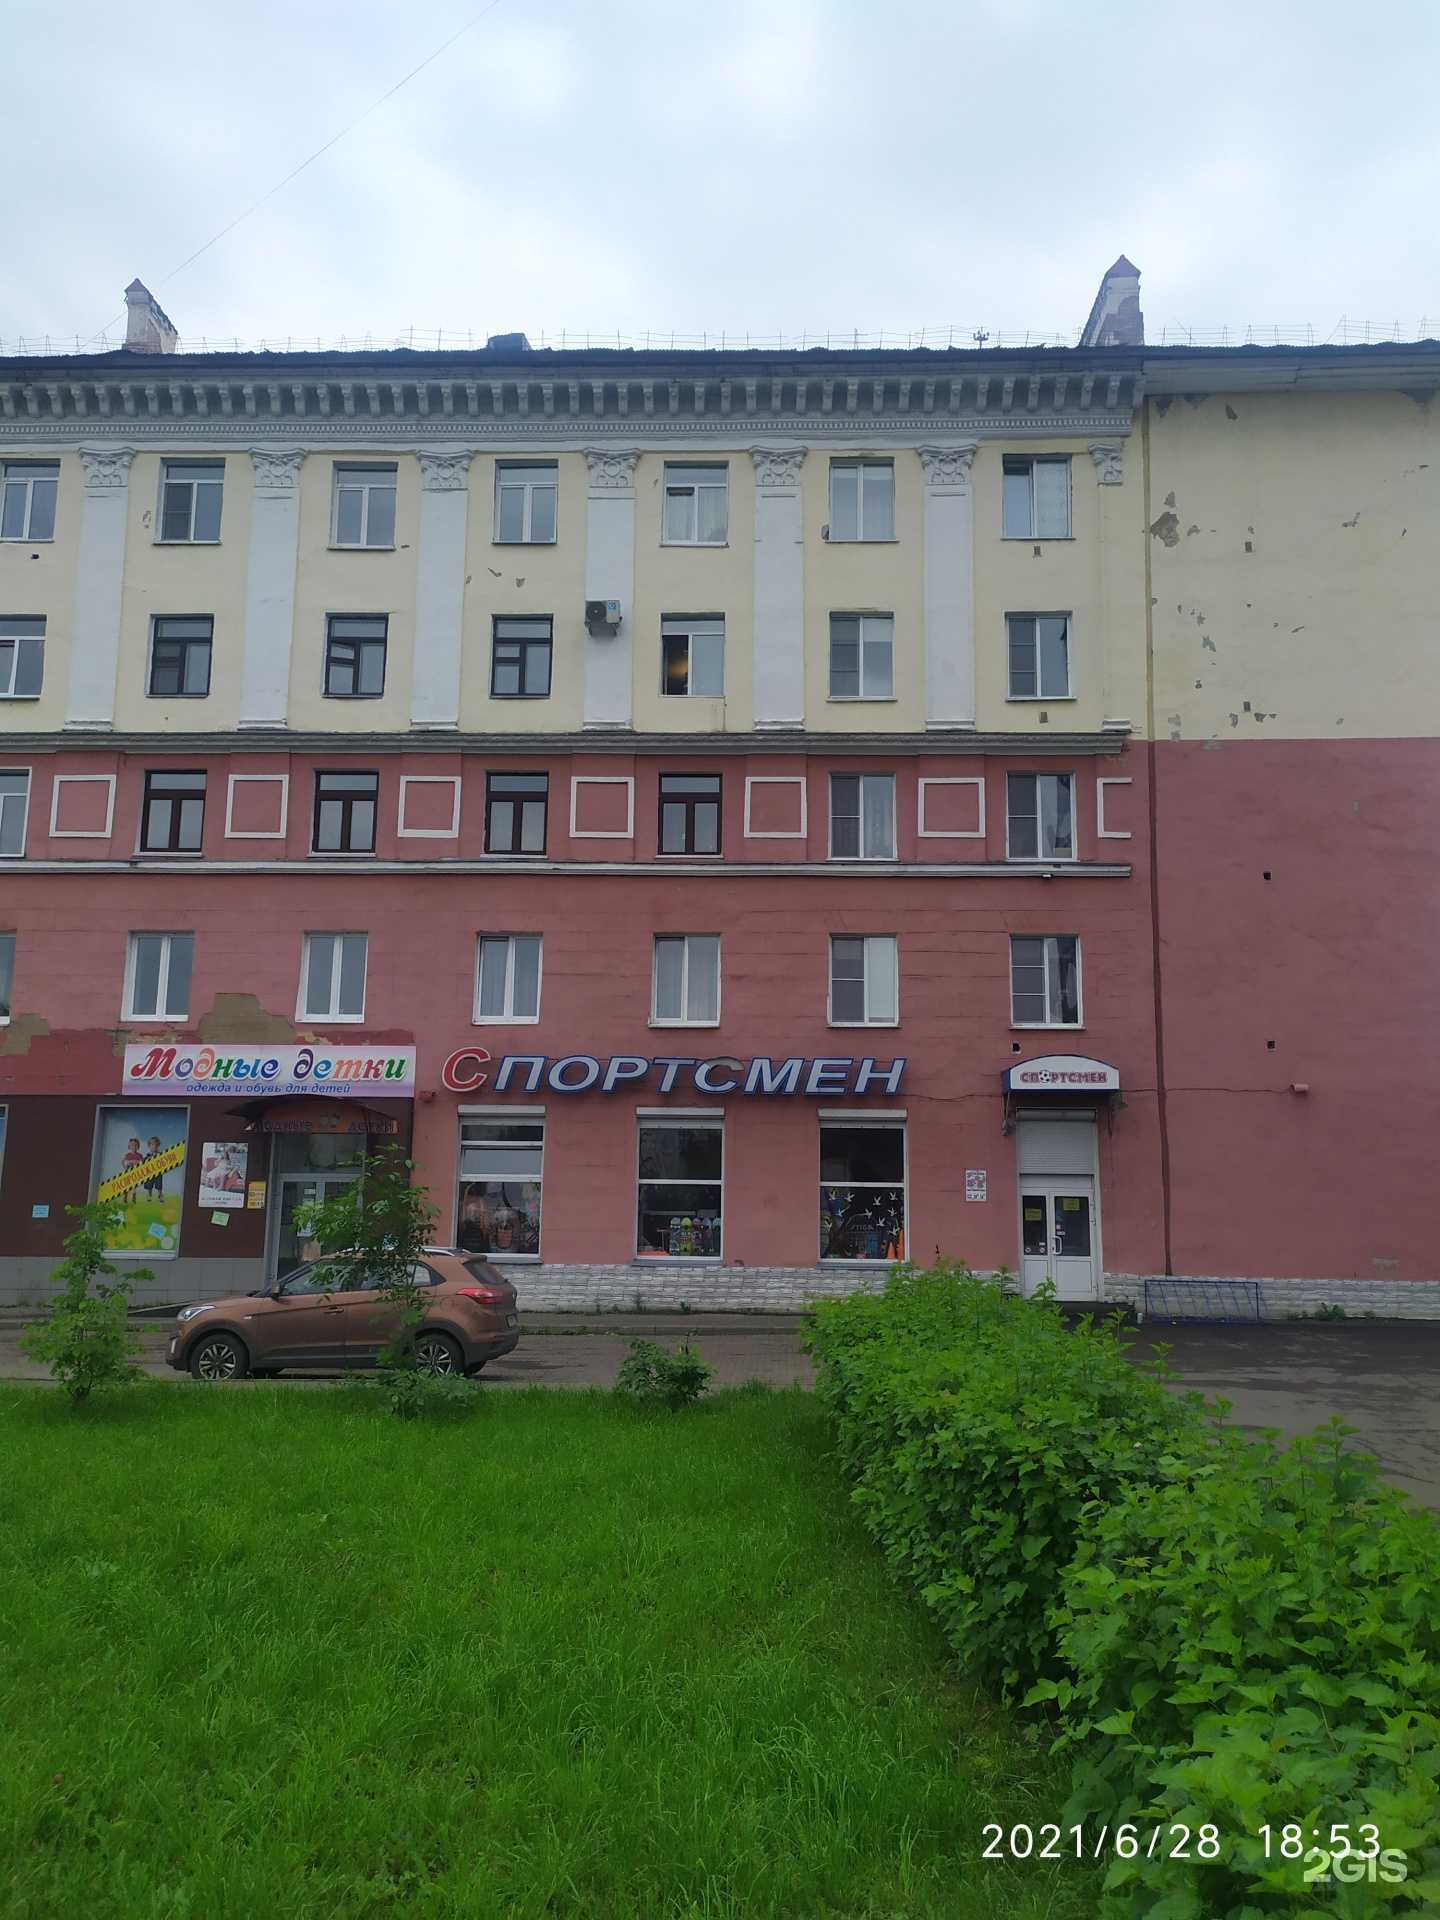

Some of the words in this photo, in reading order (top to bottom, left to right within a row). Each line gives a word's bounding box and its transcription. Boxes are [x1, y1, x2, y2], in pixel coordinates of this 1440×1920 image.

[130, 1047, 279, 1080] Модные
[292, 1048, 407, 1081] детки
[441, 1047, 907, 1095] СПОРТСМЕН
[186, 1083, 231, 1093] одежда
[235, 1084, 242, 1093] и
[246, 1083, 282, 1094] обувь
[285, 1083, 308, 1093] для
[311, 1083, 351, 1094] детей
